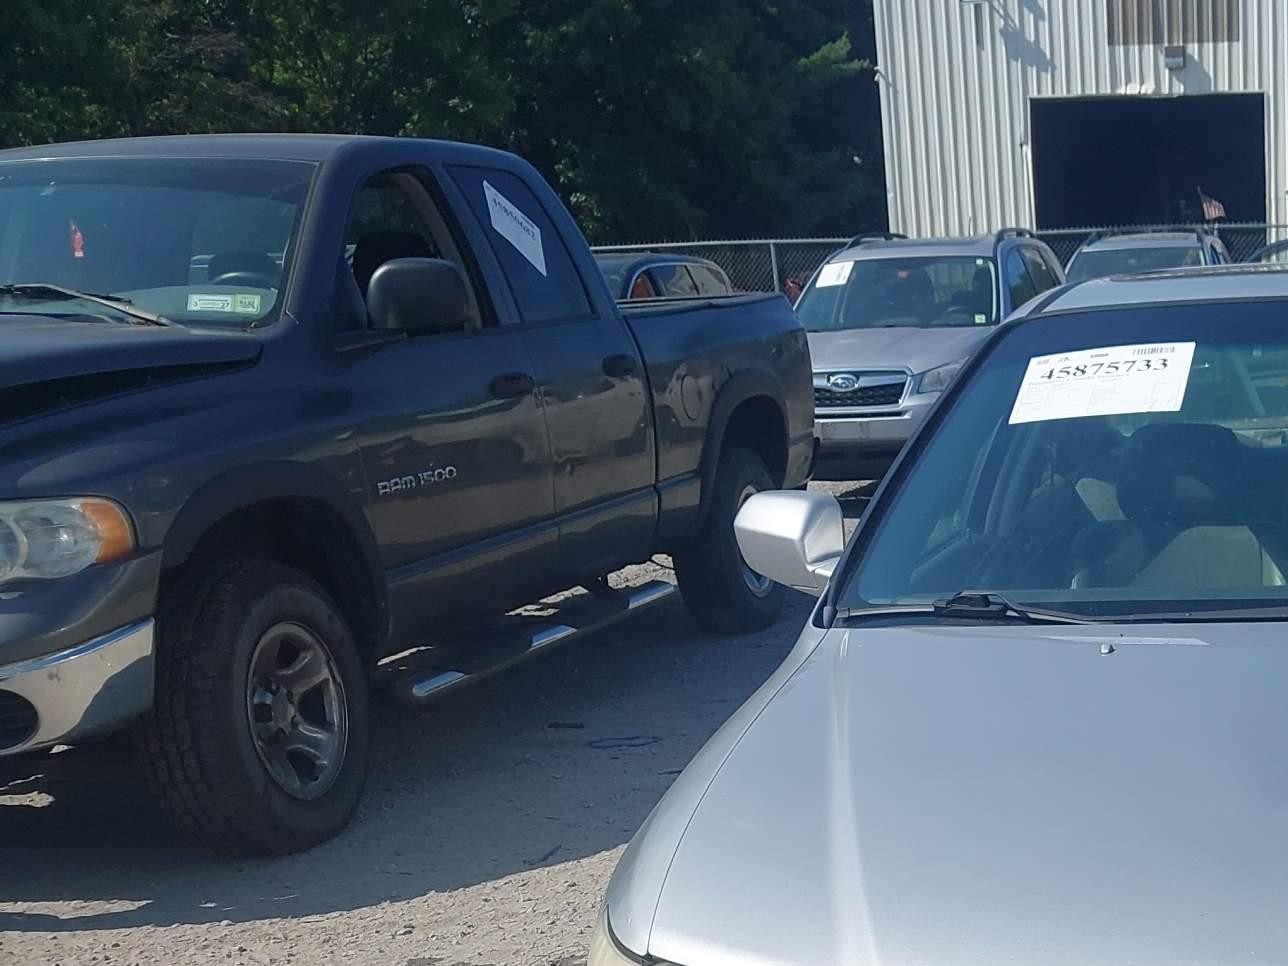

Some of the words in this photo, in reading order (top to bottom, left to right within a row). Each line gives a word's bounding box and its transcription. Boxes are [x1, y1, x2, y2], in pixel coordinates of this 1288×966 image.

[1040, 358, 1169, 380] 45875733
[377, 475, 416, 496] RAM
[417, 466, 457, 486] 1500
